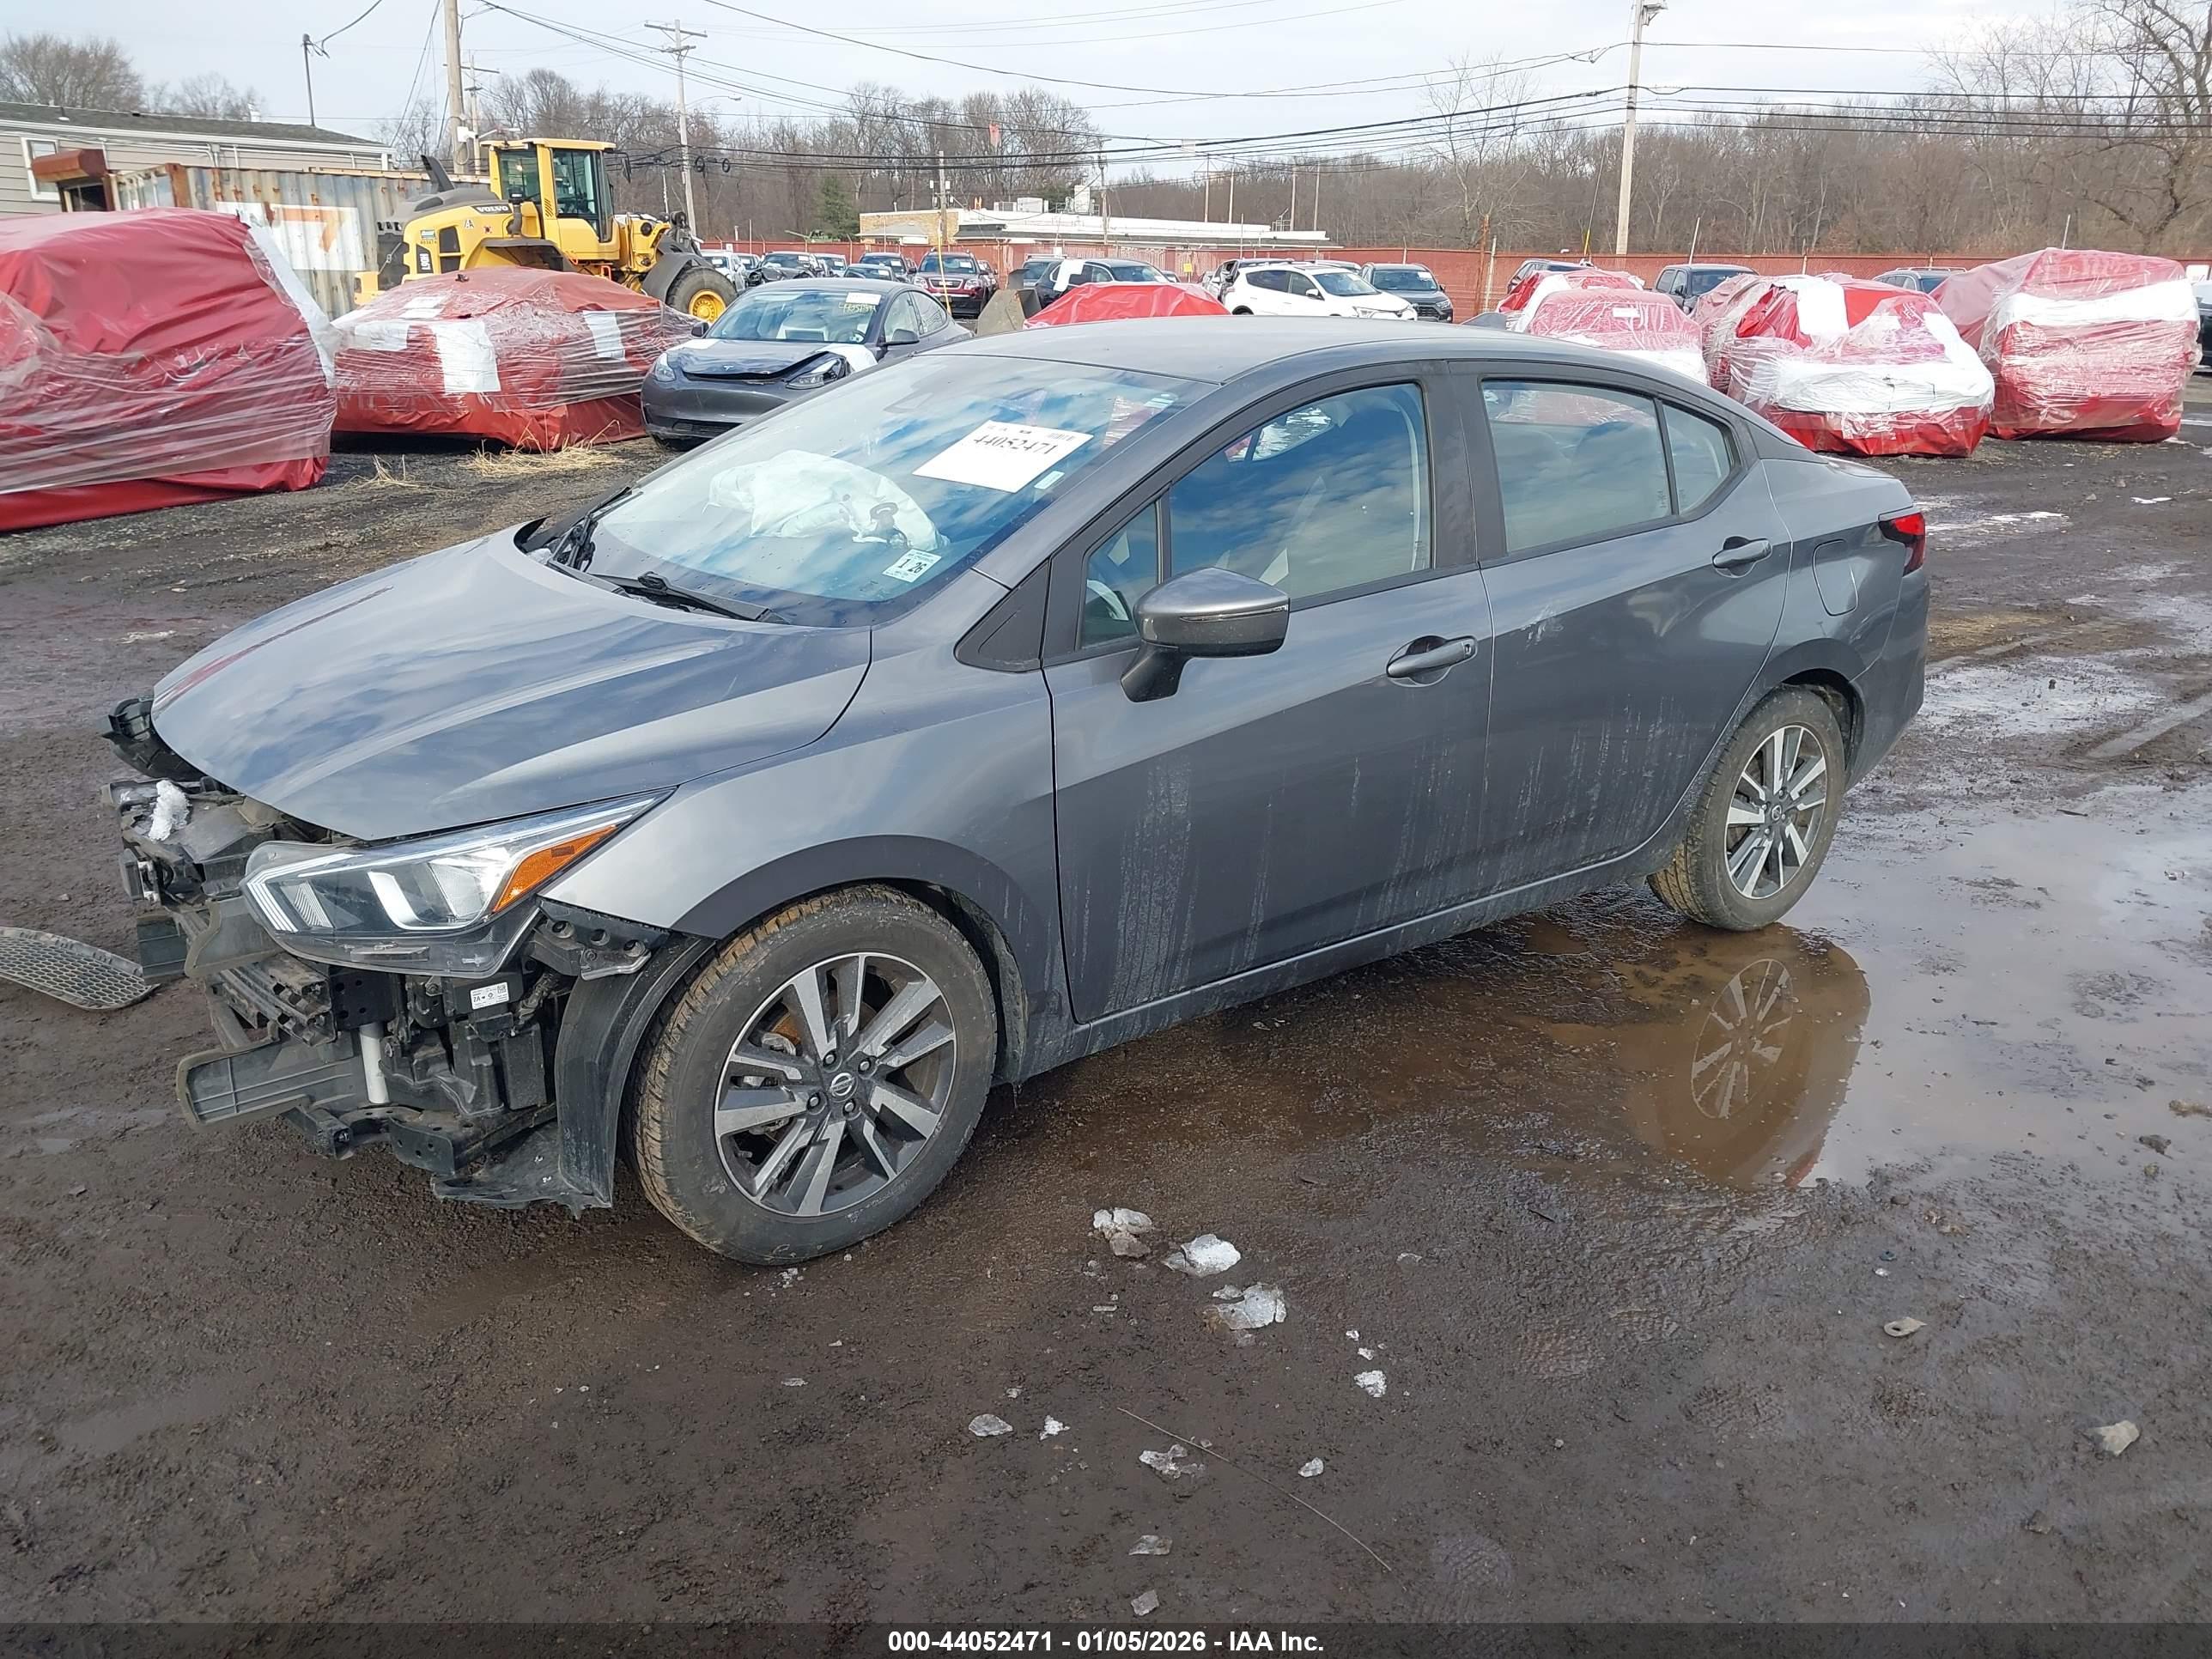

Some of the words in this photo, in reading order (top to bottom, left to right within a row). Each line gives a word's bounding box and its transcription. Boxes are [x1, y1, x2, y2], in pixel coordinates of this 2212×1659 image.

[973, 434, 1059, 454] 44052471
[897, 558, 911, 568] 1
[907, 562, 927, 574] 26
